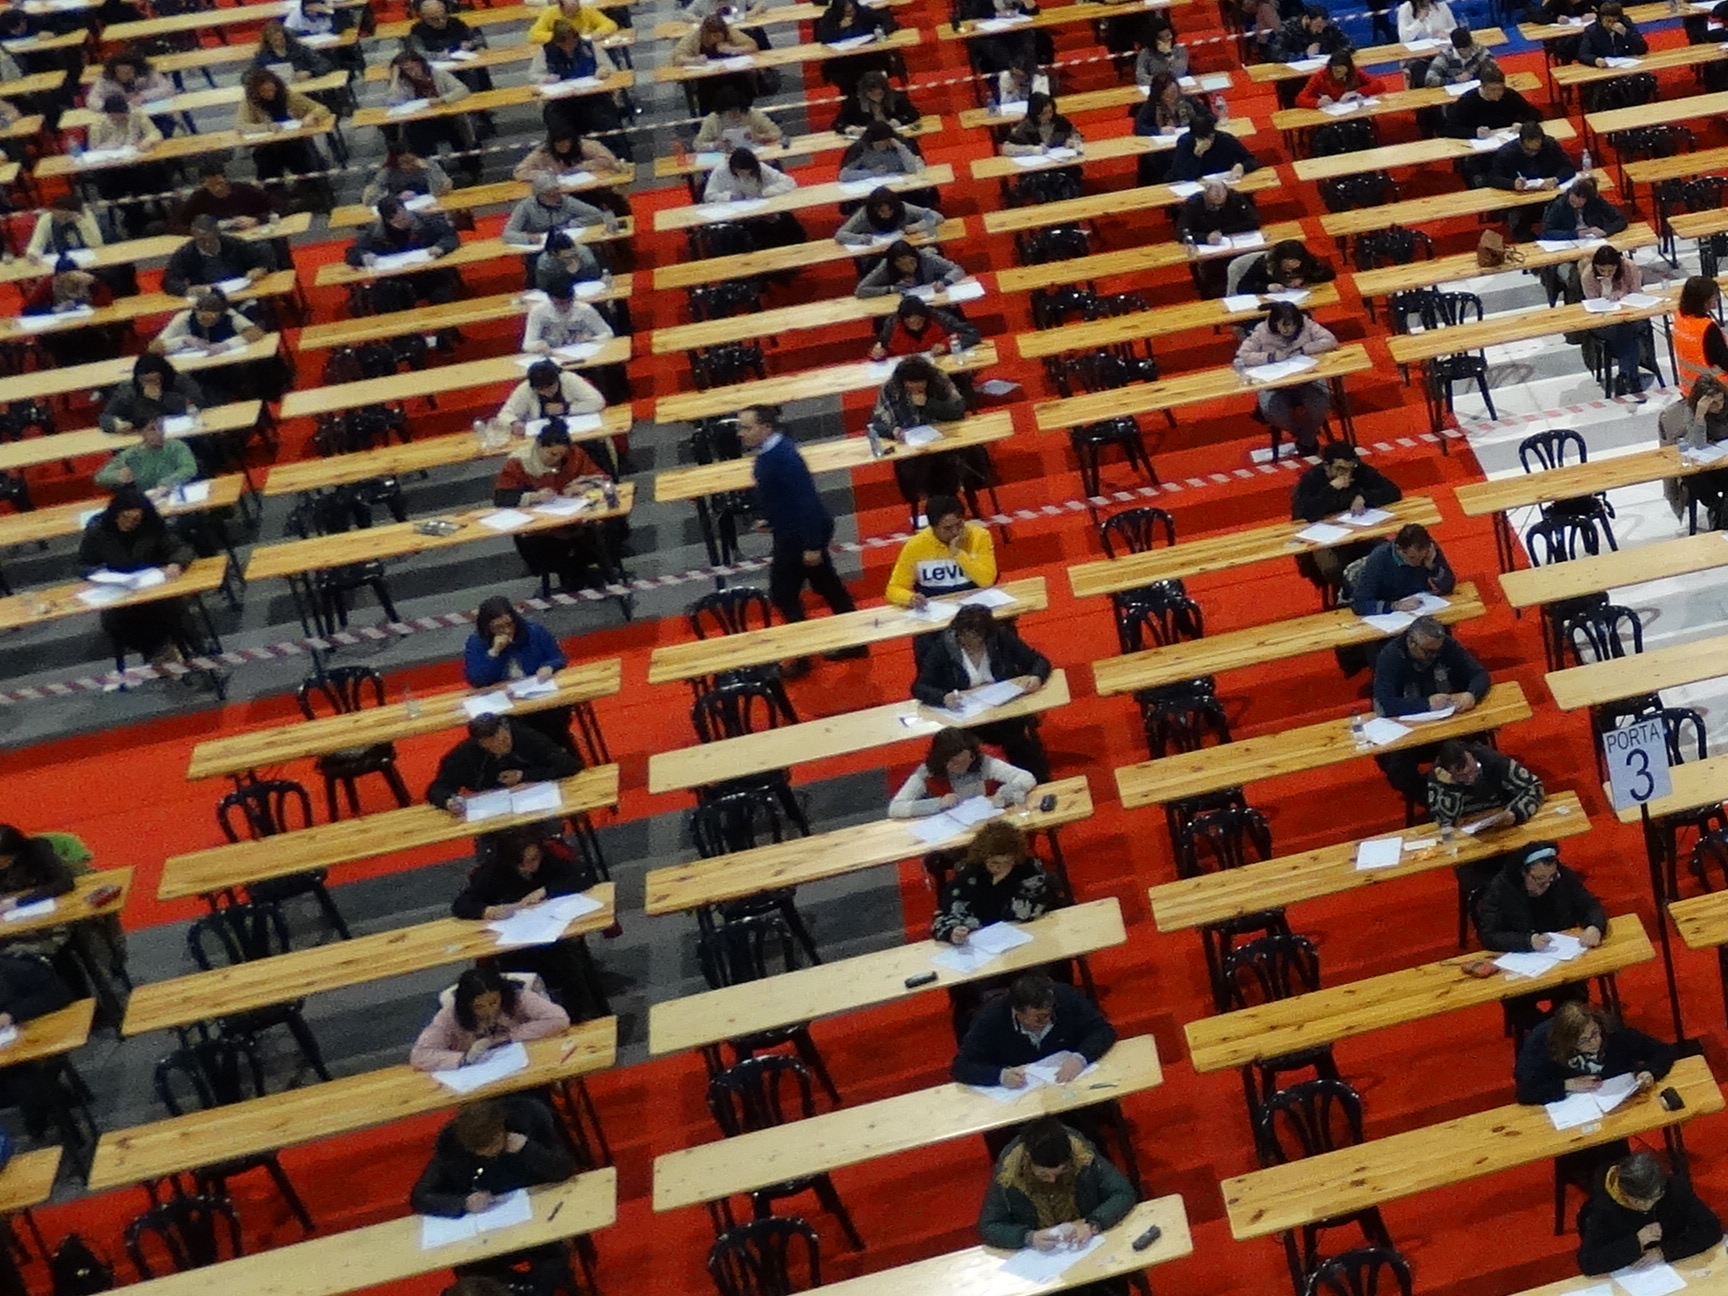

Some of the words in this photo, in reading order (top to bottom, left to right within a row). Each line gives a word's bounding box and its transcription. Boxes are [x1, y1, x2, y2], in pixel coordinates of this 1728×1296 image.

[922, 565, 965, 581] LeVI
[1607, 723, 1661, 753] PORTA
[1626, 748, 1654, 801] 3
